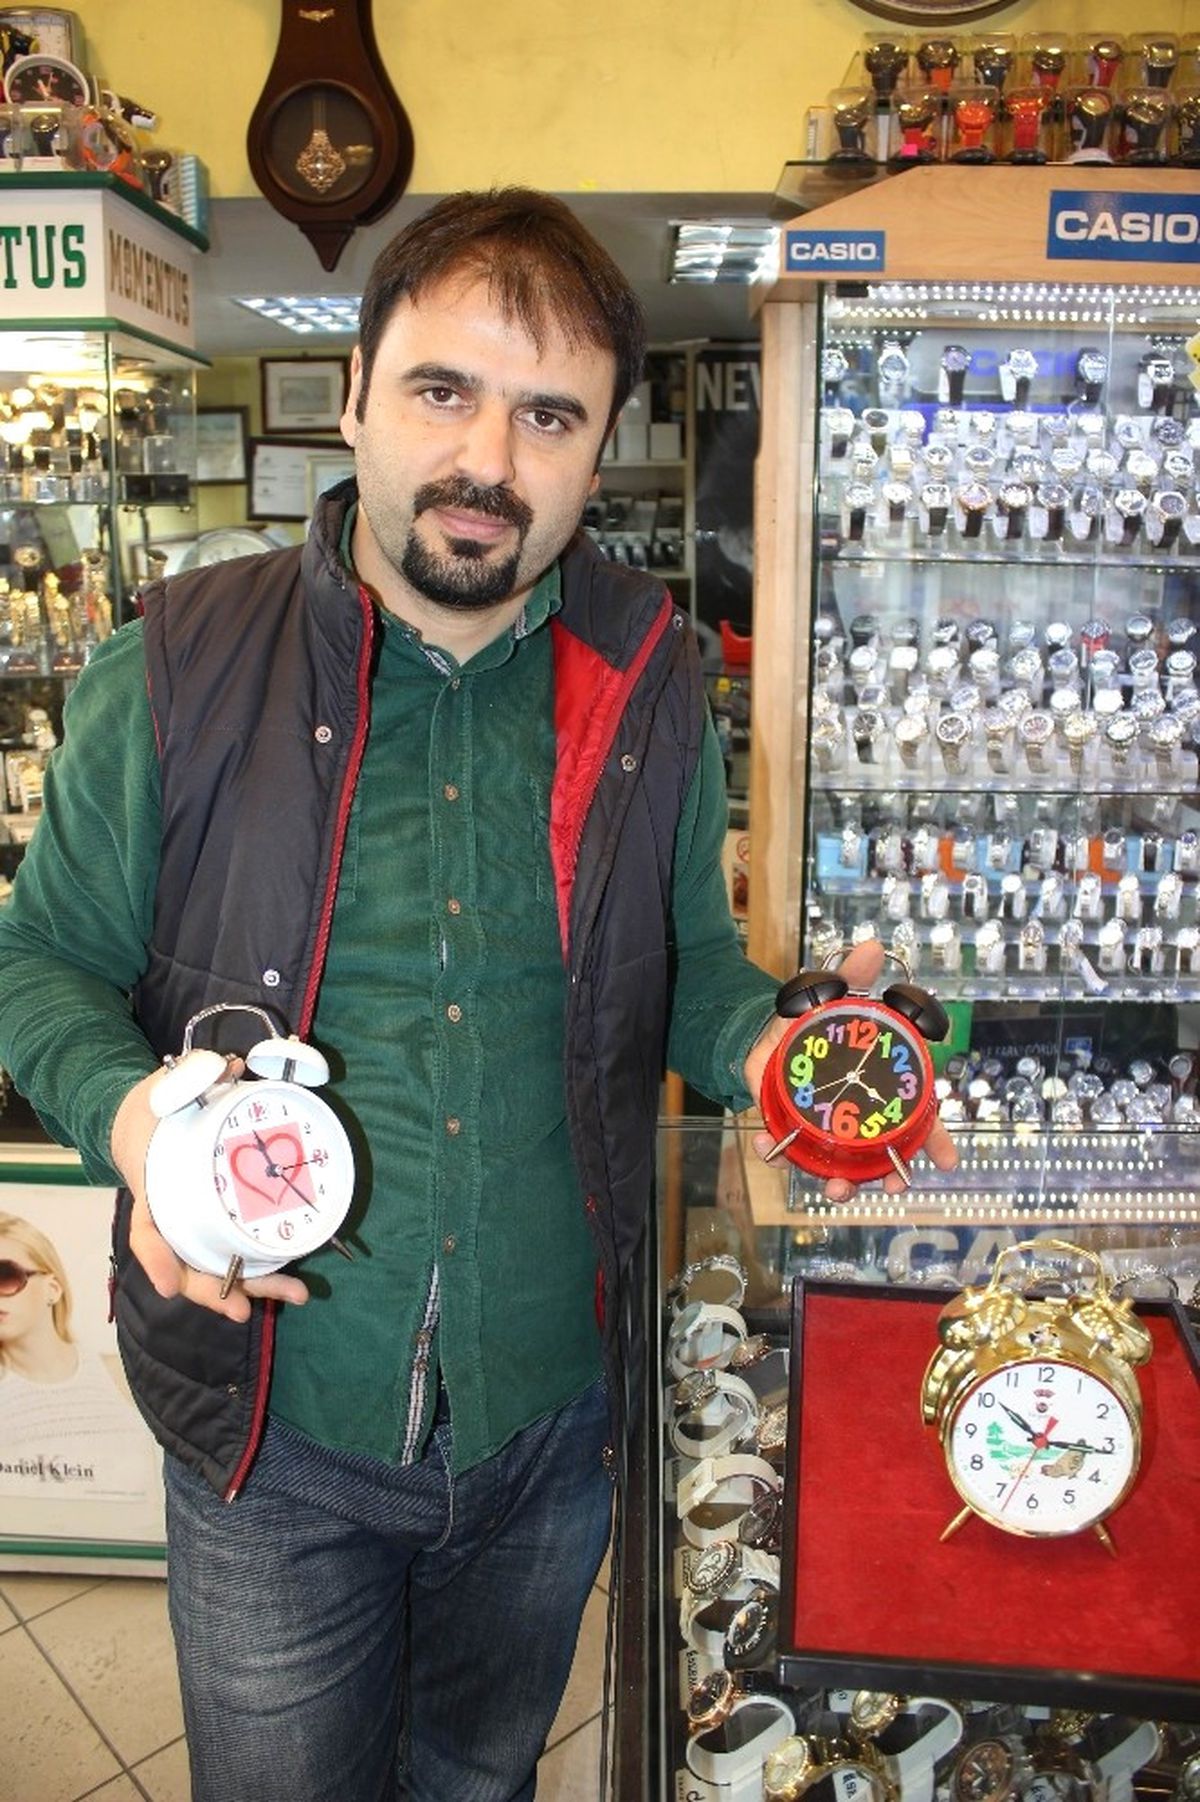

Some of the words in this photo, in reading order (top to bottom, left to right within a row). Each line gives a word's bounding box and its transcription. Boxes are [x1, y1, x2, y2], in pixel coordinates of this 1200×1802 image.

[1055, 210, 1198, 244] CASIO
[790, 242, 878, 261] CASIO
[109, 229, 190, 326] MOMENTUS
[826, 1023, 846, 1043] 11
[848, 1019, 878, 1050] 12
[803, 1036, 829, 1058] 10
[880, 1032, 892, 1058] 1
[891, 1044, 912, 1072] 2
[789, 1054, 814, 1087] 9
[794, 1082, 815, 1108] 8
[898, 1072, 917, 1100] 3
[814, 1103, 833, 1130] 7
[832, 1100, 859, 1139] 6
[883, 1097, 903, 1123] 4
[860, 1112, 887, 1138] 5
[1006, 1372, 1019, 1388] 11
[1038, 1367, 1055, 1383] 12
[1077, 1379, 1082, 1394] 1
[978, 1392, 995, 1408] 10
[1096, 1403, 1109, 1419] 2
[965, 1423, 977, 1438] 9
[1102, 1437, 1115, 1453] 3
[49, 1461, 94, 1478] Klein
[970, 1454, 984, 1471] 8
[1088, 1469, 1101, 1483] 4
[996, 1483, 1007, 1498] 7
[1063, 1490, 1075, 1504] 5
[1026, 1493, 1039, 1509] 6
